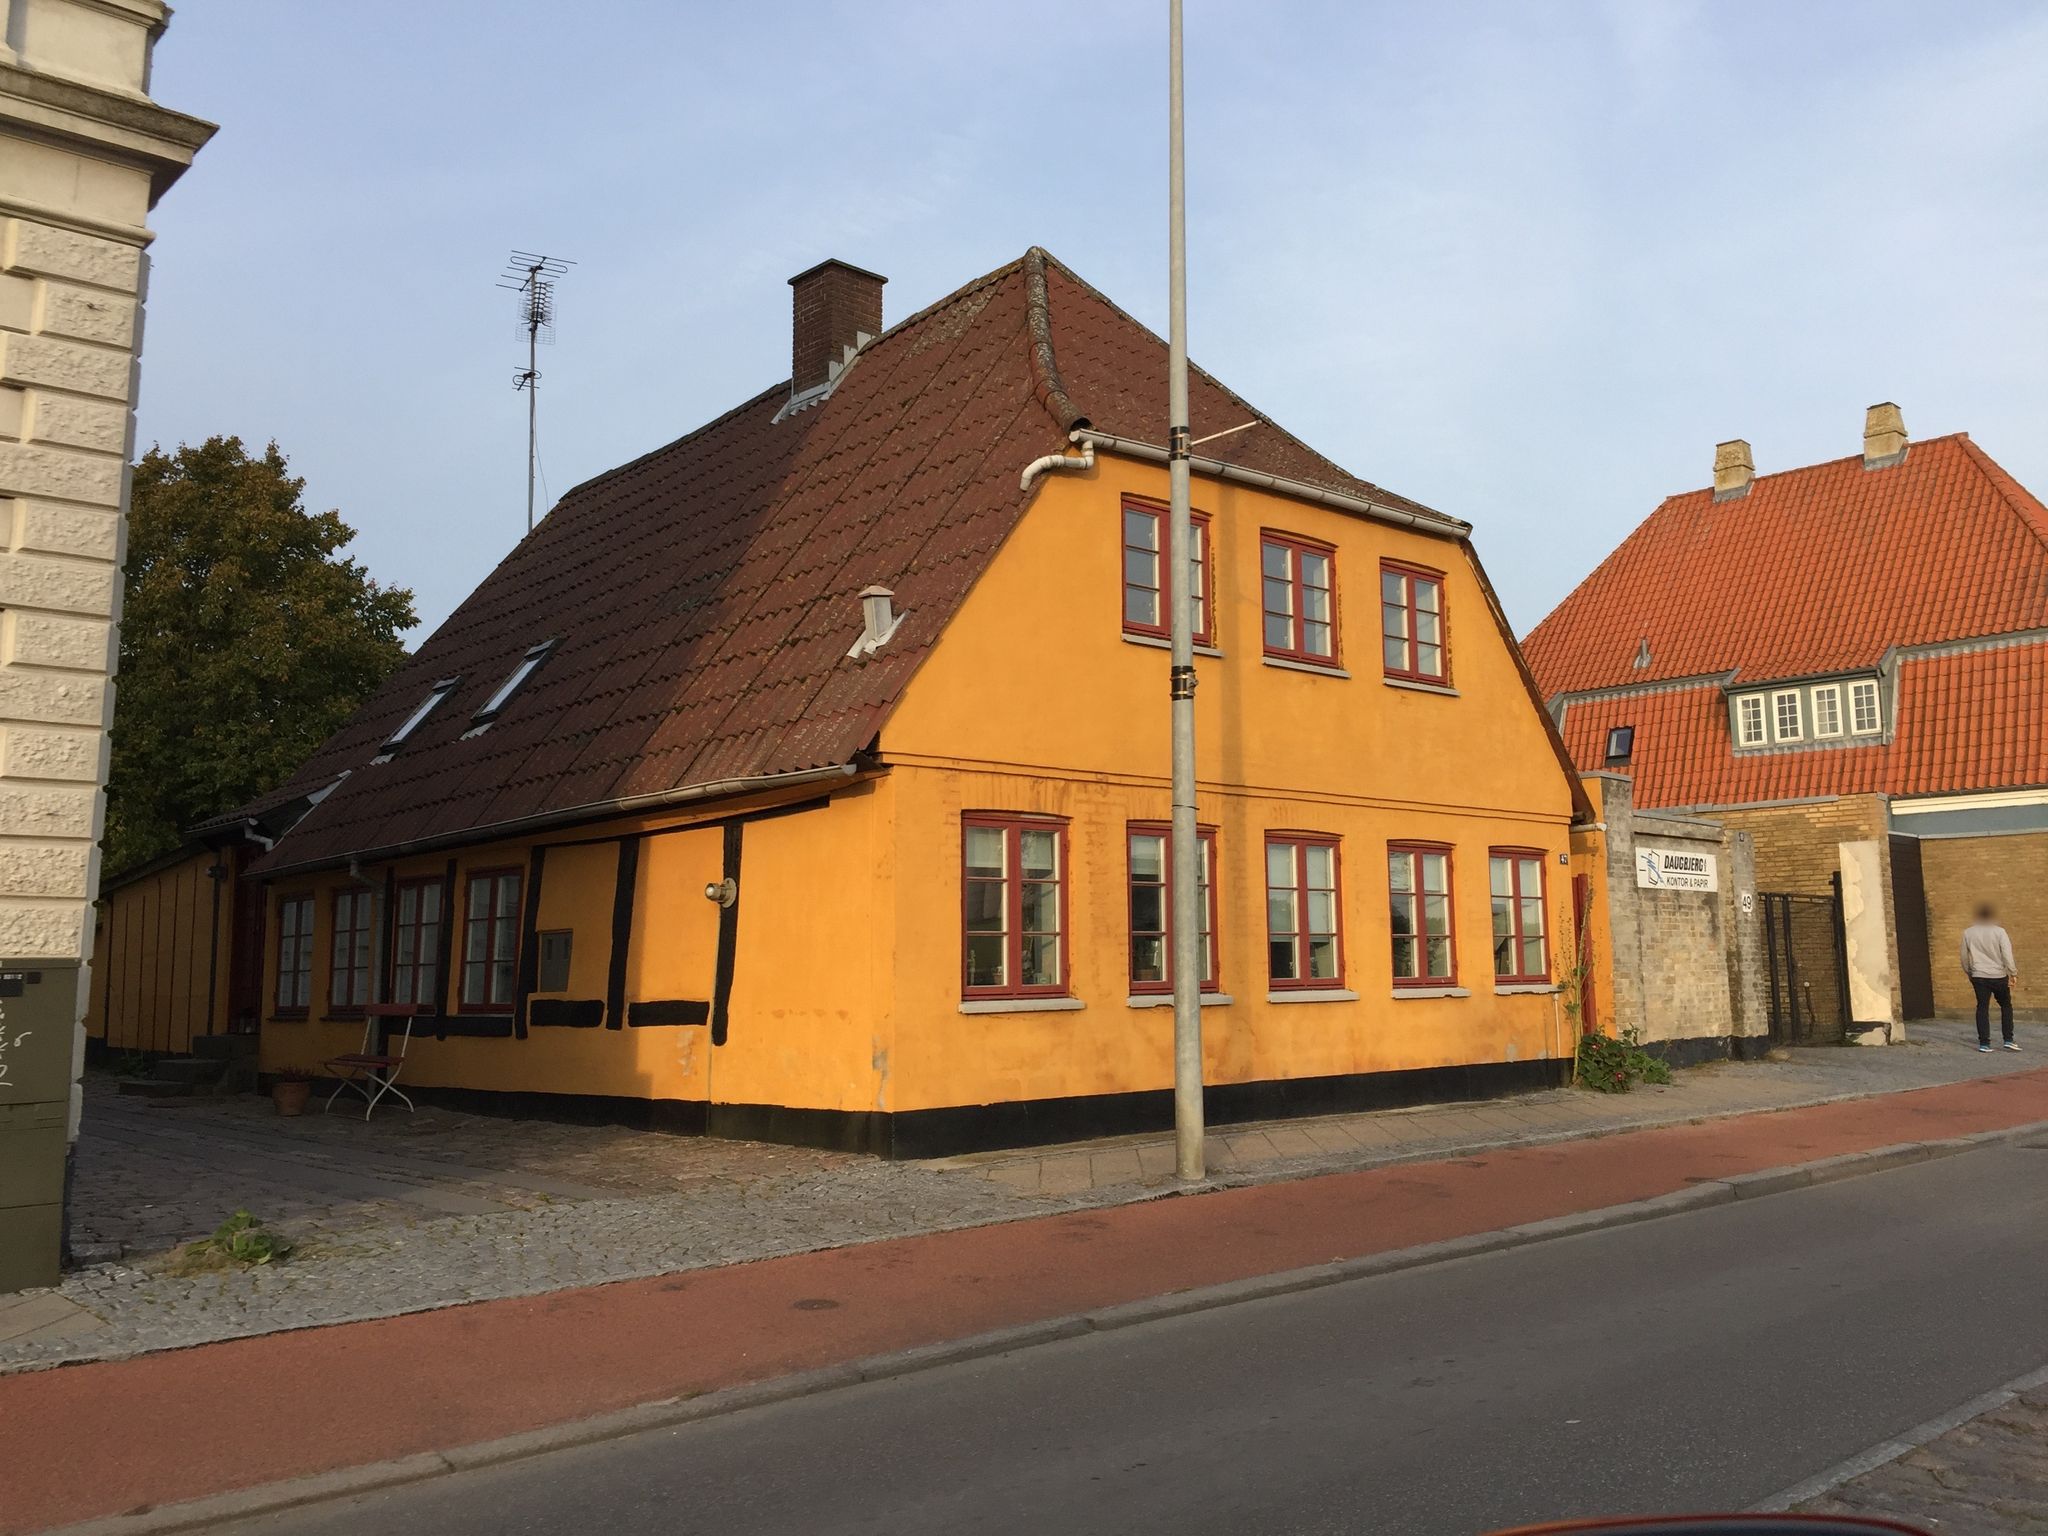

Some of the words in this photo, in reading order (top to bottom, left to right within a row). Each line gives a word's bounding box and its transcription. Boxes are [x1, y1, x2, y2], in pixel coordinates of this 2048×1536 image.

[1664, 855, 1704, 872] DAUGBJERG
[1667, 876, 1688, 887] KONTOR
[1693, 878, 1708, 888] PAPIR
[1743, 895, 1752, 910] 49
